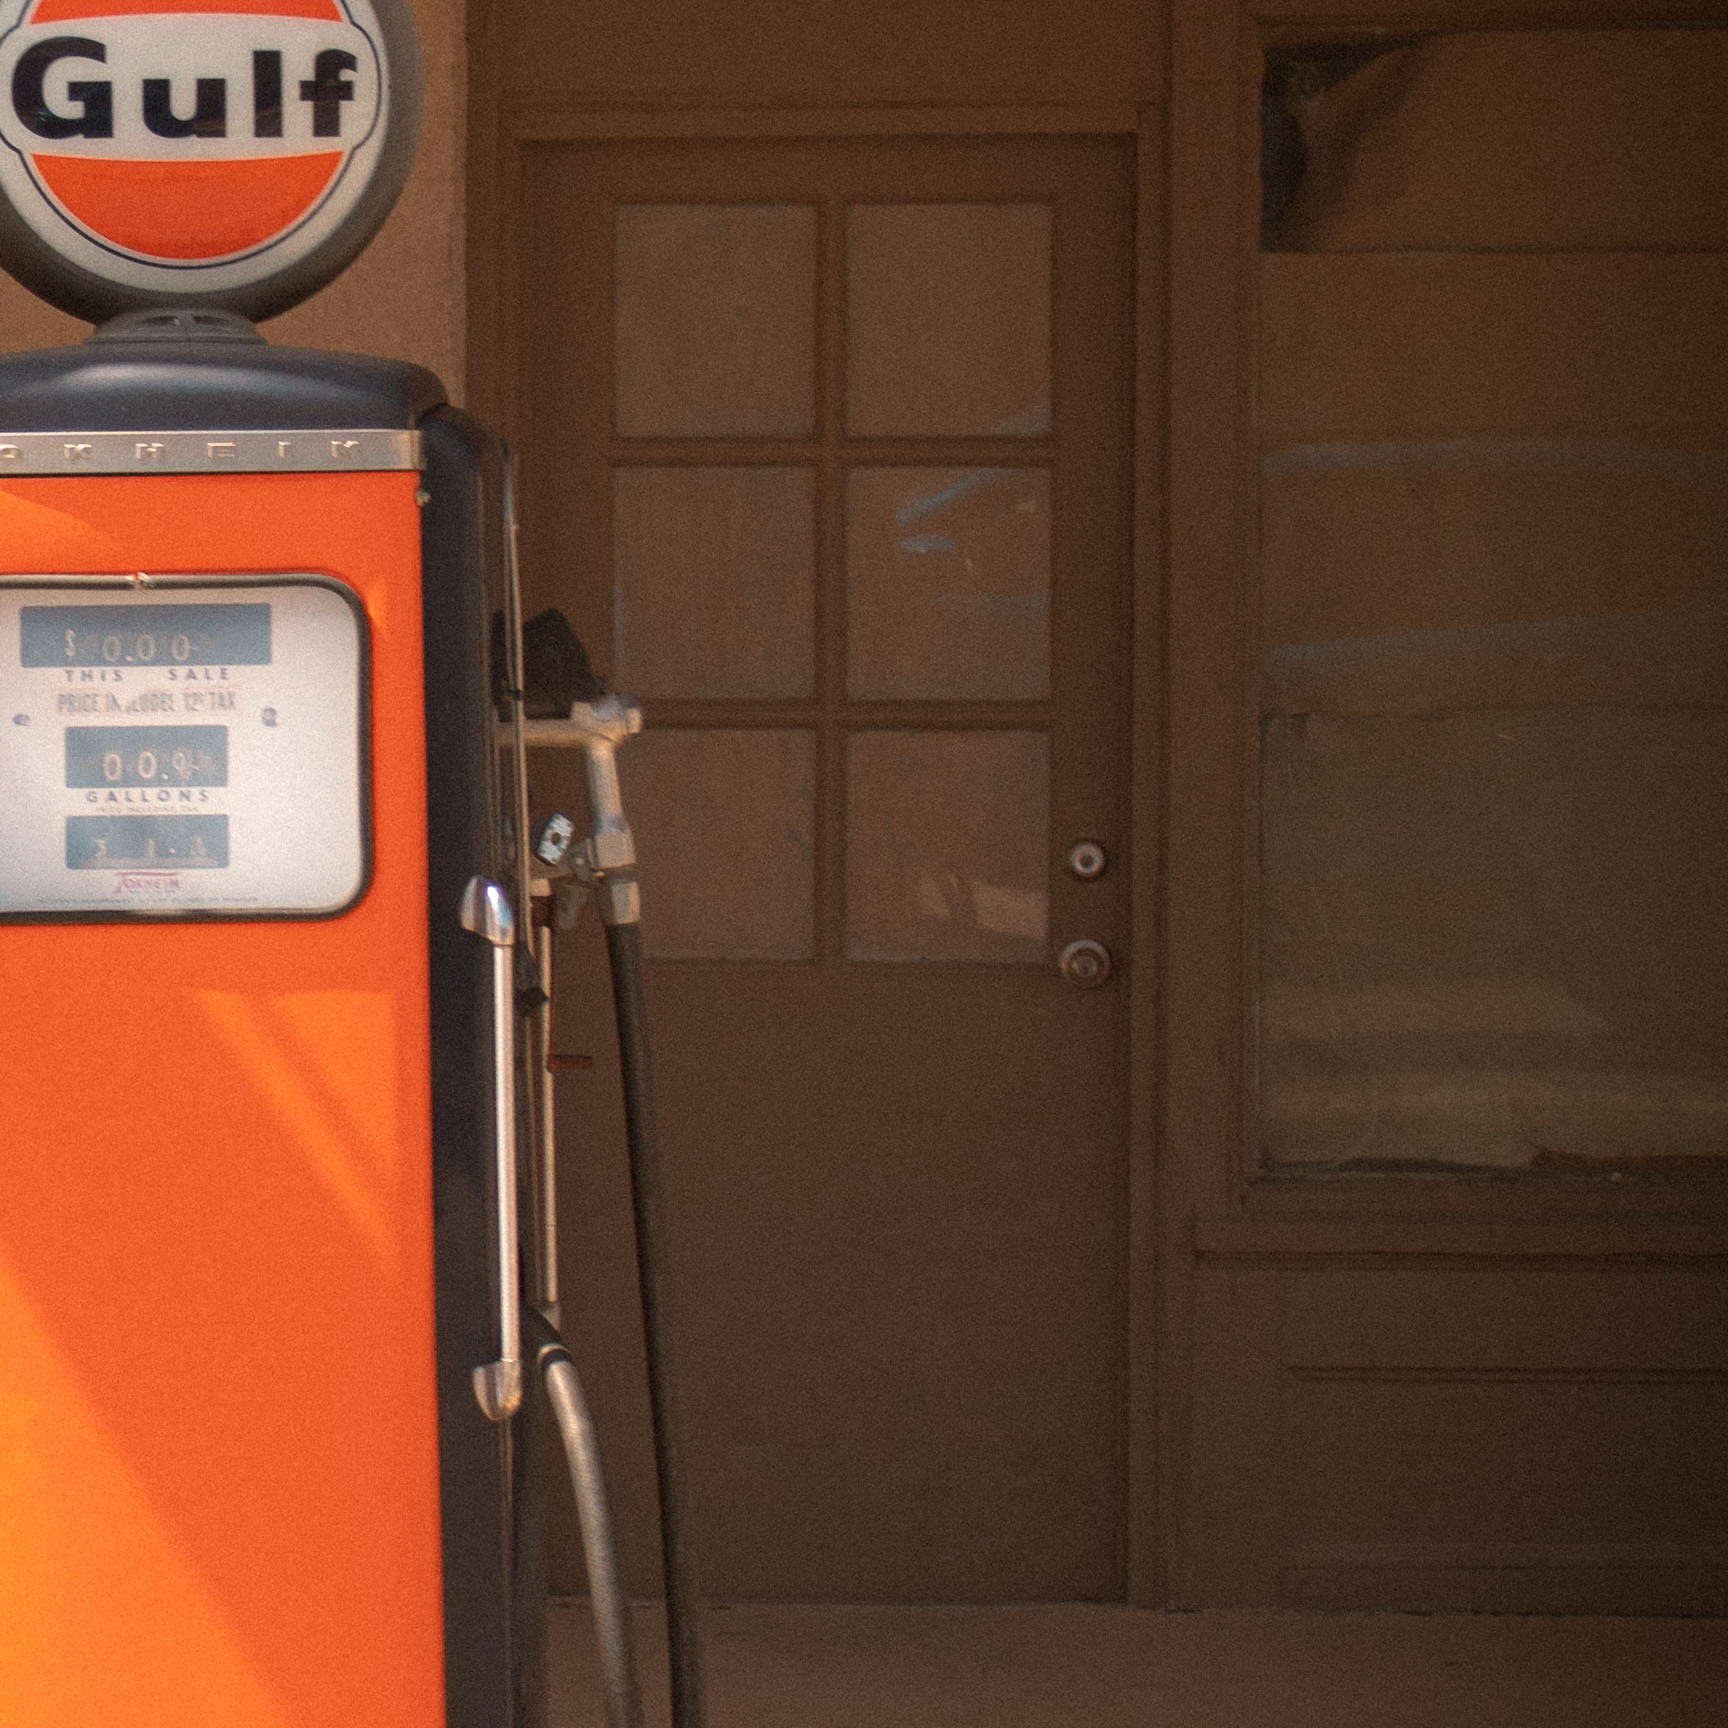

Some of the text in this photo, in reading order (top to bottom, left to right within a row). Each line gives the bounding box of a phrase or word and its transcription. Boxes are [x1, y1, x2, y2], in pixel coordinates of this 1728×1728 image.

[12, 35, 359, 139] Gulf
[65, 667, 230, 683] THIS SALE
[57, 692, 99, 712] PRICE
[86, 789, 209, 804] GALLONS
